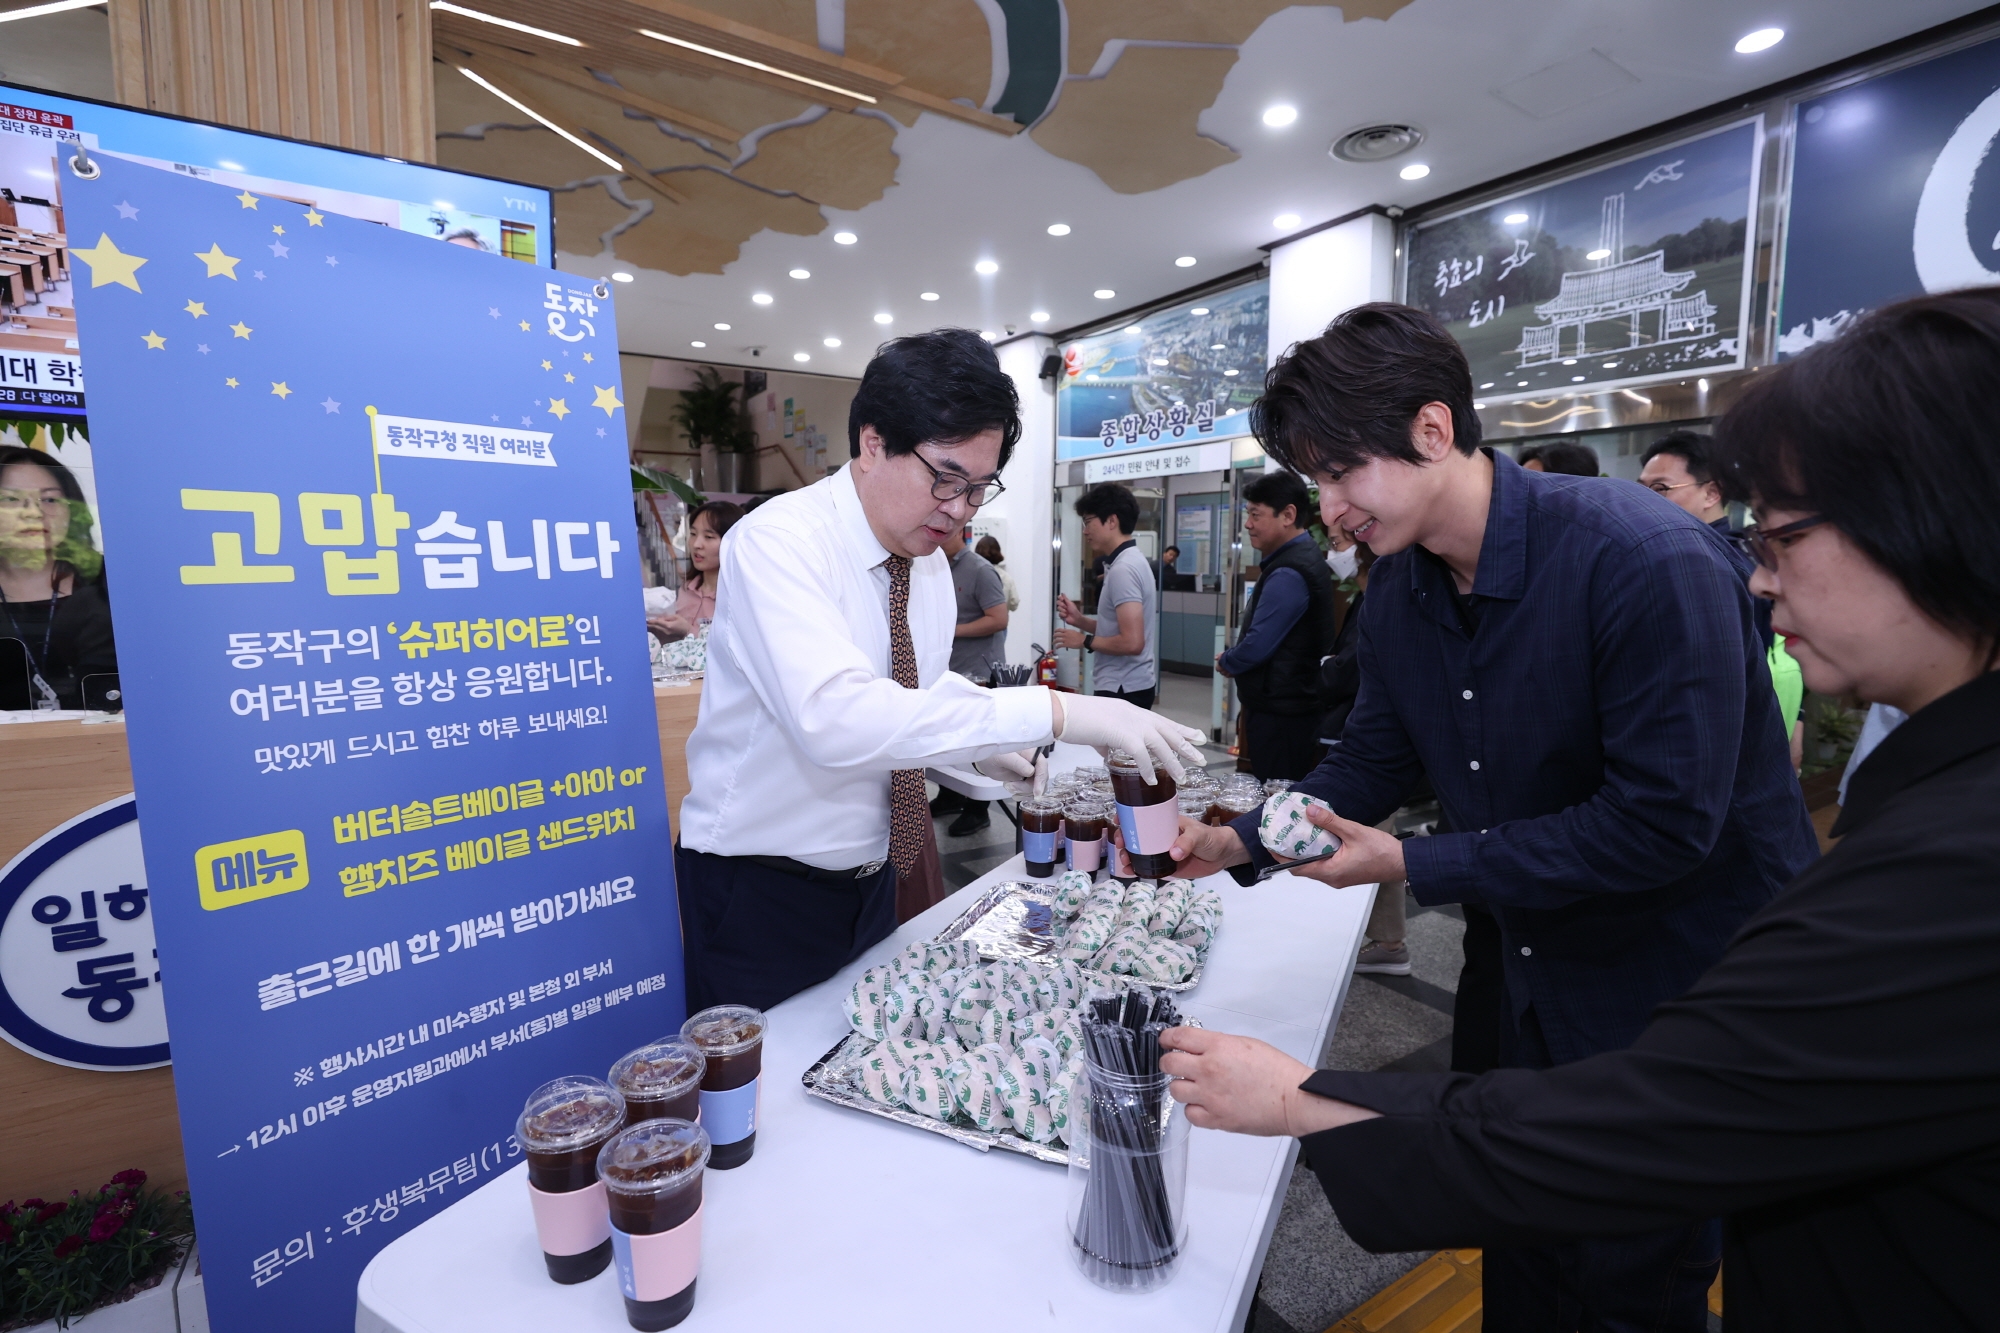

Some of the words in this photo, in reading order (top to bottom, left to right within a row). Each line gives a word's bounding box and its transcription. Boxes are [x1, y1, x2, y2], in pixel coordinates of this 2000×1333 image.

[0, 119, 25, 134] 집단
[28, 122, 53, 139] 유급
[13, 106, 37, 122] 정원
[40, 111, 64, 127] 윤곽
[503, 196, 537, 213] YTN
[543, 282, 599, 343] 동작
[1468, 294, 1506, 328] 도시
[47, 359, 82, 387] 학
[387, 425, 457, 452] 동작구청
[462, 433, 496, 455] 직원
[500, 437, 546, 459] 여러분
[1101, 399, 1216, 448] 종합상황실
[1103, 464, 1125, 475] 24시간
[1128, 461, 1143, 474] 민원
[1145, 458, 1160, 471] 안내
[1164, 457, 1172, 469] 및
[1175, 454, 1191, 468] 접수
[180, 488, 620, 595] 고맙습니다
[225, 626, 380, 669] 동작구의
[229, 676, 384, 721] 여러분을
[391, 669, 457, 706] 항상
[465, 657, 613, 696] 응원합니다.
[254, 739, 336, 774] 맛있게
[347, 730, 419, 760] 드시고
[426, 722, 471, 749] 힘찬
[478, 716, 521, 741] 하루
[528, 705, 608, 735] 보내세요!
[333, 779, 544, 844] 버터솔트베이글
[620, 766, 646, 787] or
[211, 848, 299, 893] 메뉴
[338, 849, 440, 898] 햄치즈
[445, 829, 531, 873] 베이글
[536, 806, 636, 852] 샌드위치
[257, 942, 401, 1012] 출근길에
[407, 930, 440, 965] 한
[446, 911, 505, 953] 개씩
[511, 876, 636, 935] 받아가세요
[61, 948, 162, 1023] 동
[319, 1032, 405, 1079] 행사시간
[409, 1025, 430, 1046] 내
[433, 997, 505, 1037] 미수령자
[508, 989, 526, 1010] 및
[528, 977, 561, 1003] 본청
[564, 970, 580, 990] 외
[583, 958, 614, 982] 부서
[246, 1112, 298, 1150] 12시
[302, 1094, 348, 1127] 이후
[351, 1040, 487, 1108] 운영지원과에서
[490, 1009, 569, 1052] 부서(동)별
[571, 996, 602, 1022] 일괄
[604, 984, 634, 1008] 배부
[636, 973, 667, 996] 예정
[250, 1230, 314, 1289] 문의
[341, 1134, 523, 1236] 후생복무팀(13
